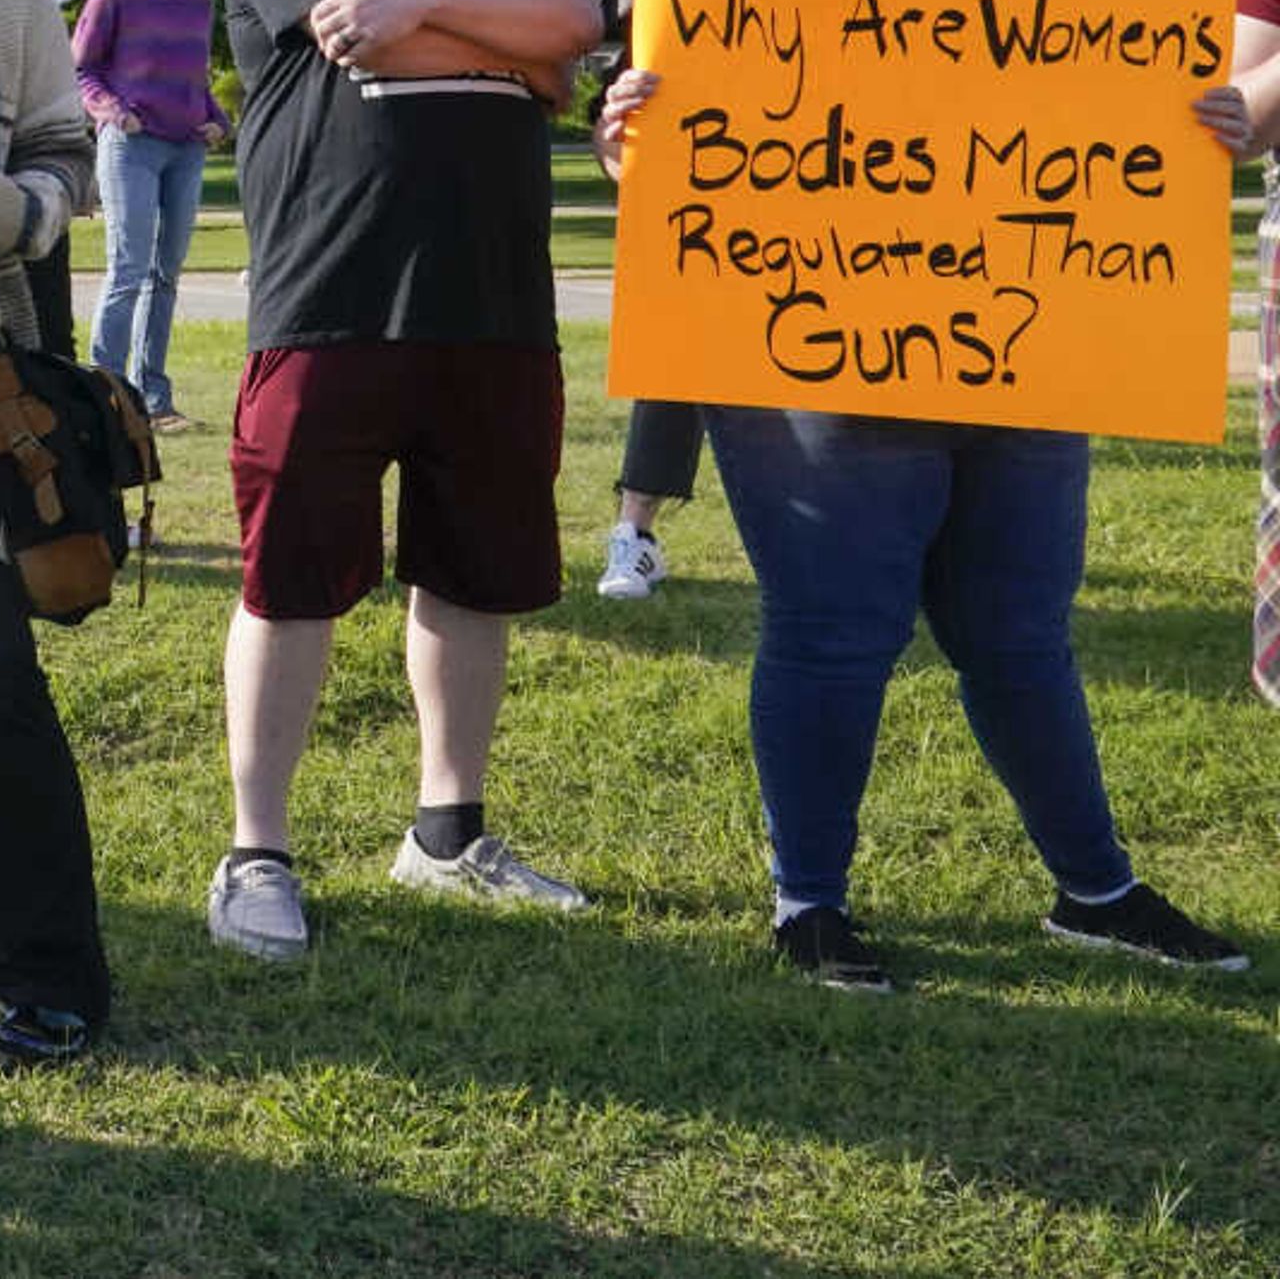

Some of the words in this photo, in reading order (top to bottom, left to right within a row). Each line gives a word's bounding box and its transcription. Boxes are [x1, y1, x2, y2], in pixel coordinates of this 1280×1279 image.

[679, 102, 938, 195] Bodies
[963, 125, 1167, 203] More
[666, 203, 991, 304] Regulated
[995, 210, 1176, 284] Than
[765, 286, 1040, 387] Guns?
